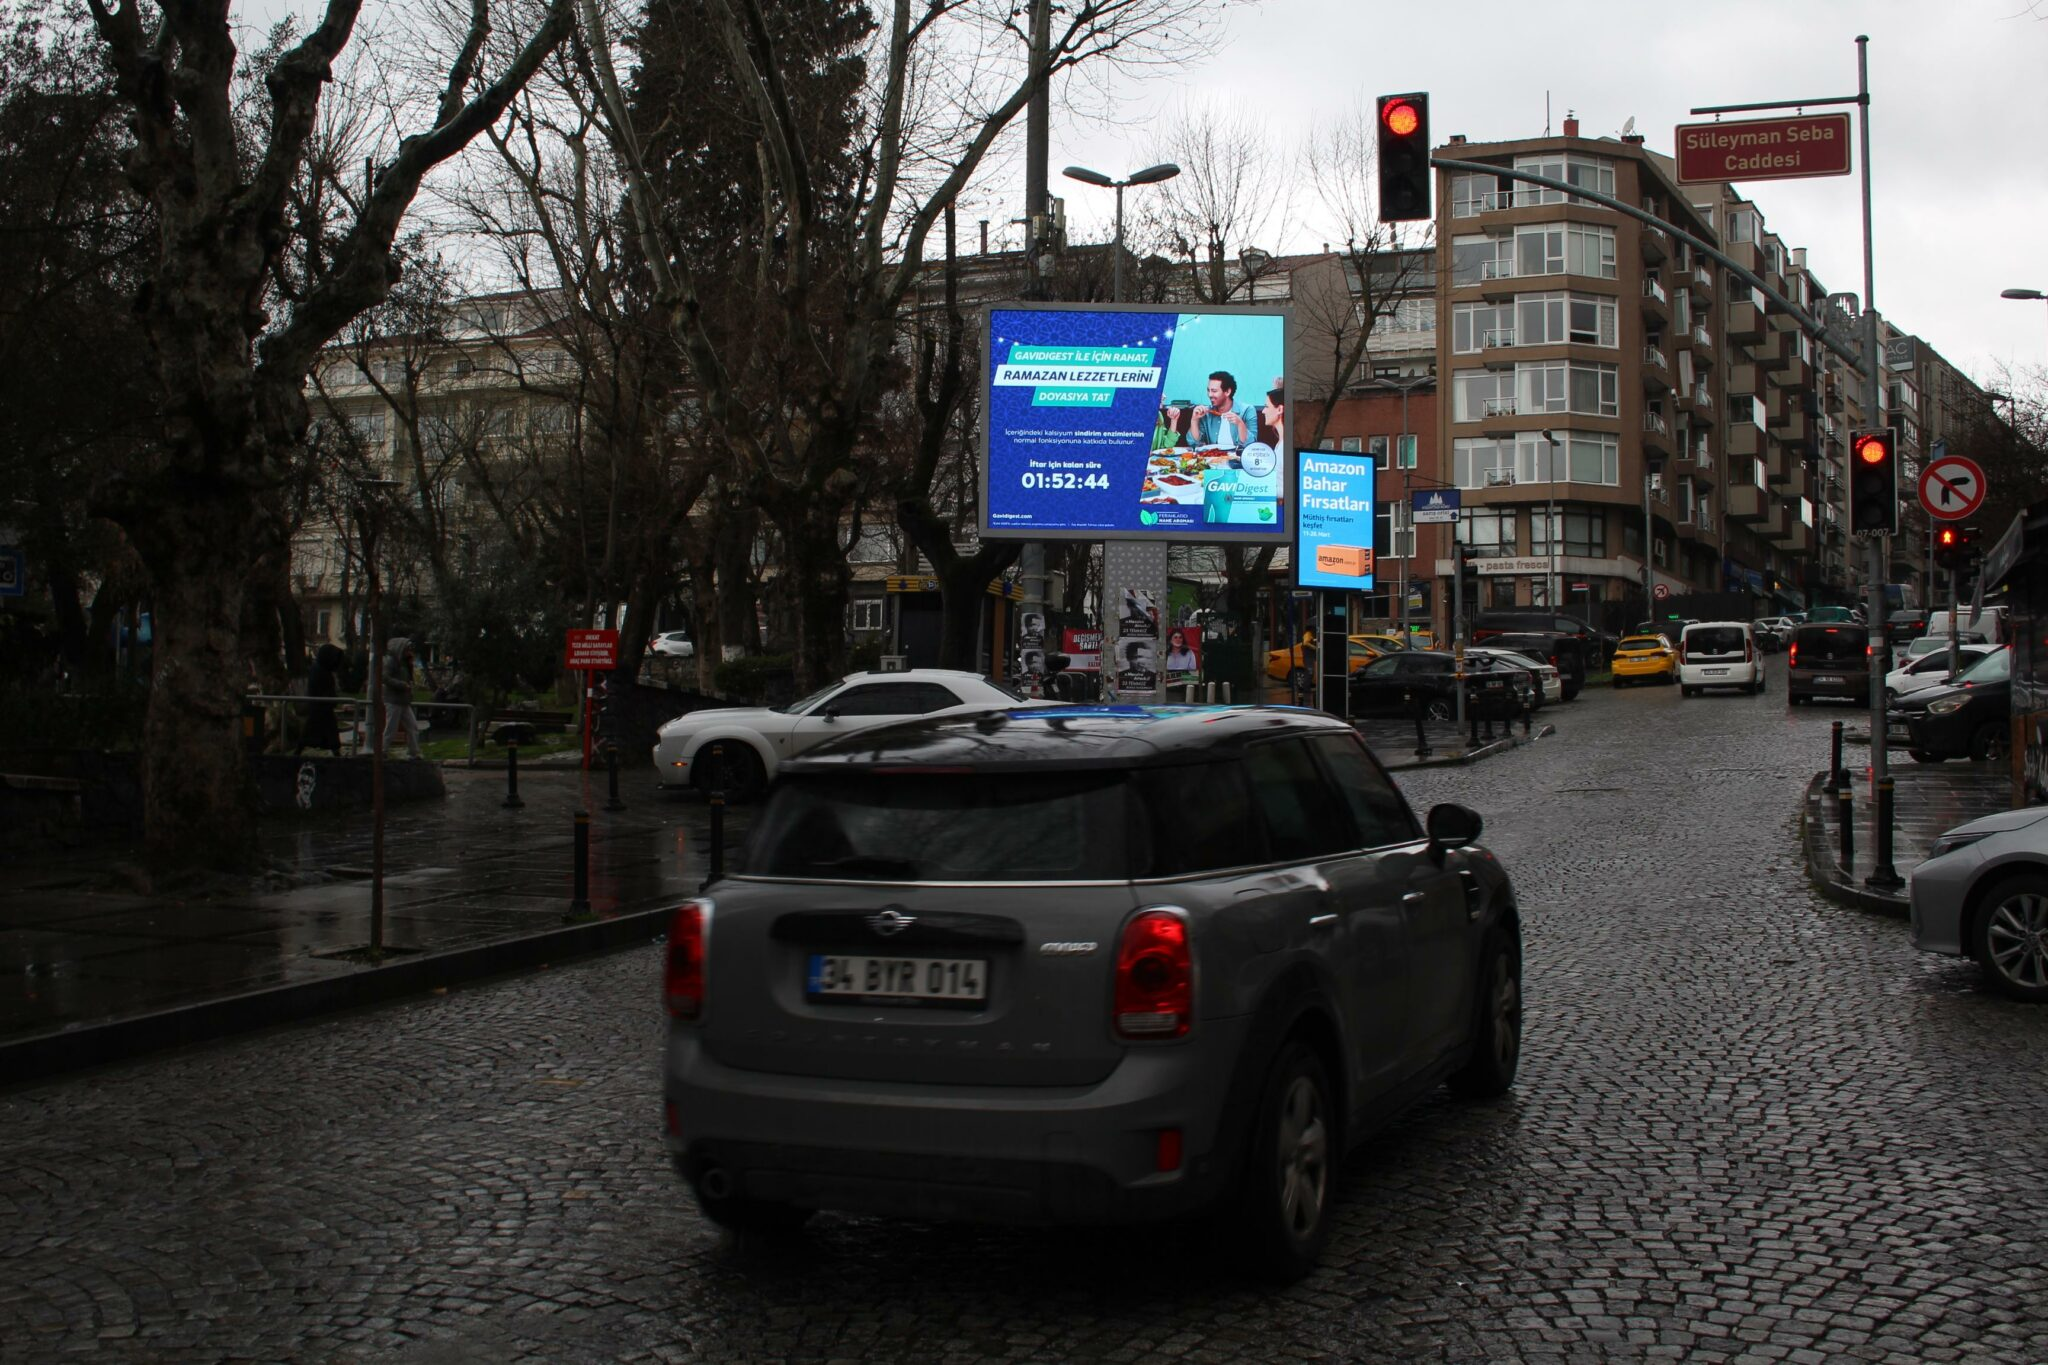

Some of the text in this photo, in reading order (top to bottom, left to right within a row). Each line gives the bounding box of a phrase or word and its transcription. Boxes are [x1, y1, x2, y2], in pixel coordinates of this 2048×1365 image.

[1686, 125, 1834, 150] Süleyman Seba
[1725, 150, 1801, 171] Caddesi
[1015, 350, 1148, 364] GAVIDIGEST İLE İÇİN RAHAT,
[1003, 369, 1154, 383] RAMAZAN LEZZETLERİNİ
[1039, 392, 1111, 402] DOYASIYA TAT
[1005, 428, 1044, 437] İçeriğindeki
[1045, 429, 1073, 438] kalsiyum
[1038, 437, 1082, 446] fonksiyonuna
[1108, 438, 1136, 446] bulunur.
[1030, 459, 1047, 469] İftar
[1063, 461, 1083, 469] kalan
[1085, 461, 1102, 470] süre
[1303, 458, 1366, 476] Amazon
[1021, 472, 1110, 490] 01:52:44
[1303, 476, 1348, 493] Bahar
[1207, 481, 1268, 496] GAVIDigest
[1303, 494, 1370, 512] Fırsatları
[1303, 513, 1354, 524] Müthiş fırsatları
[1303, 522, 1323, 532] keşfet
[1318, 555, 1344, 565] amazon
[1486, 561, 1514, 572] pasta
[1517, 560, 1549, 570] fresca
[822, 958, 978, 996] 34 BYR 014
